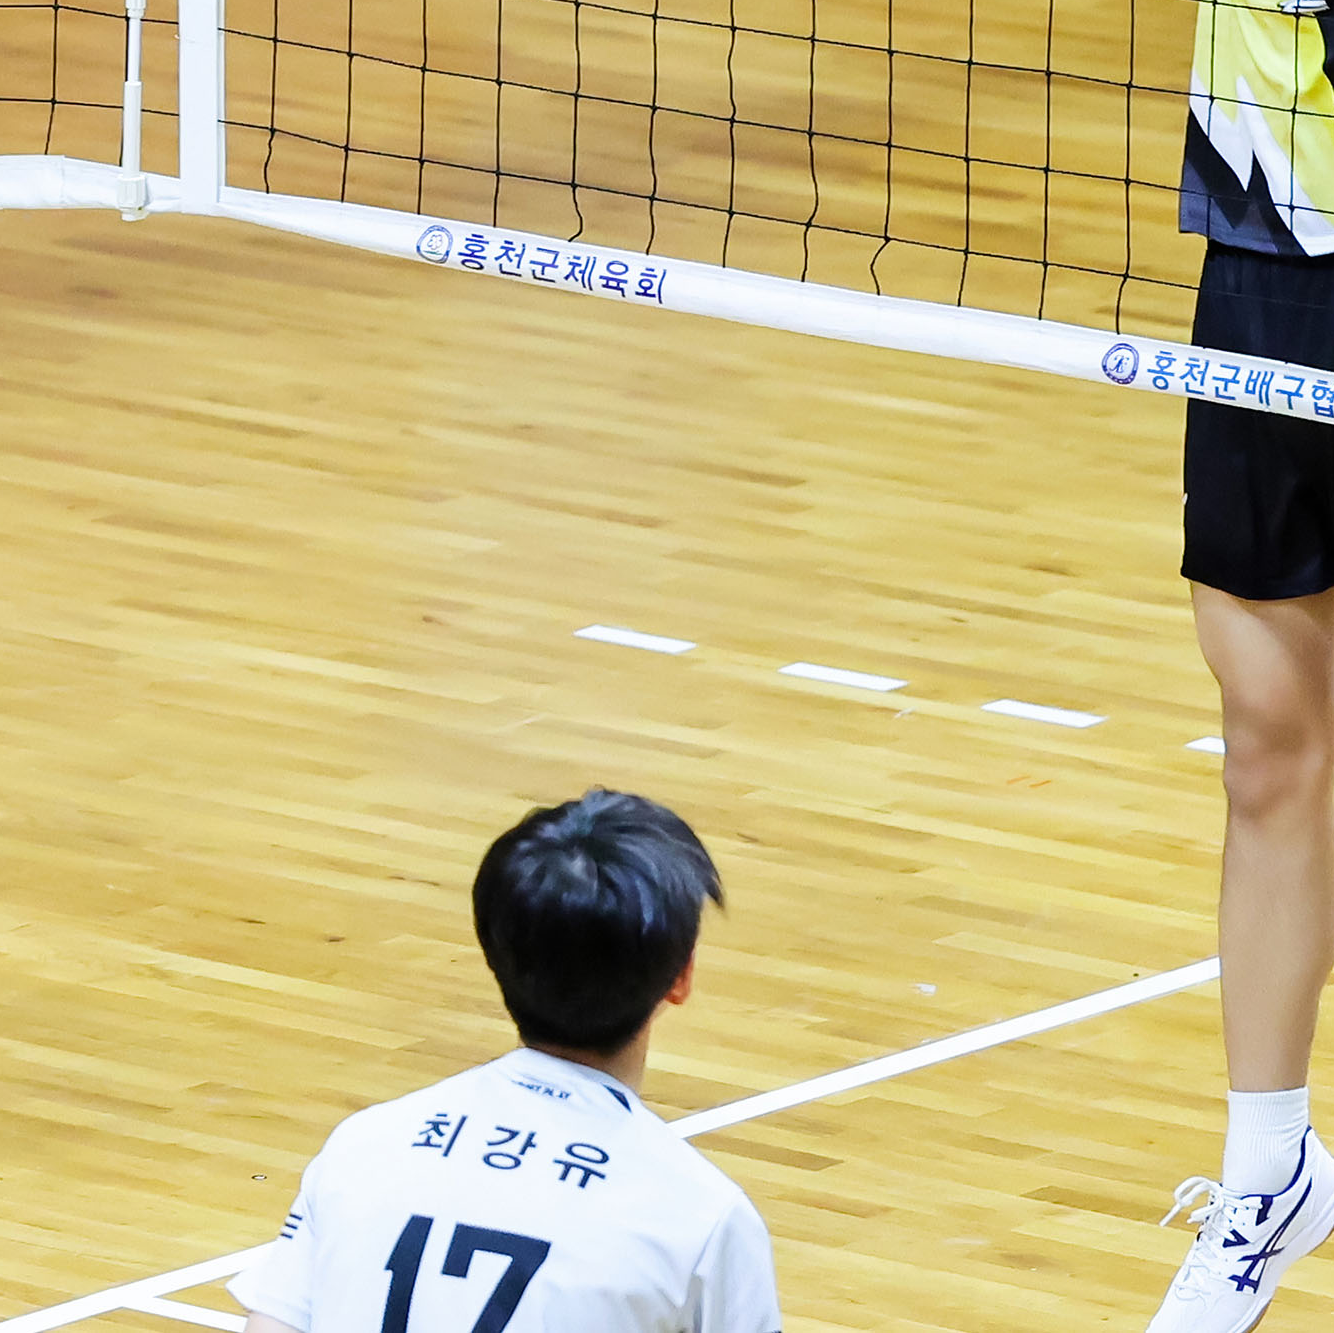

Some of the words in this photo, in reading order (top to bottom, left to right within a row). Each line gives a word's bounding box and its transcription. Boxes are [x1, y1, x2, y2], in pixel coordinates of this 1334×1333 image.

[457, 233, 667, 304] 홍천군체육회
[411, 1112, 611, 1189] 최강유
[381, 1214, 552, 1333] 17
